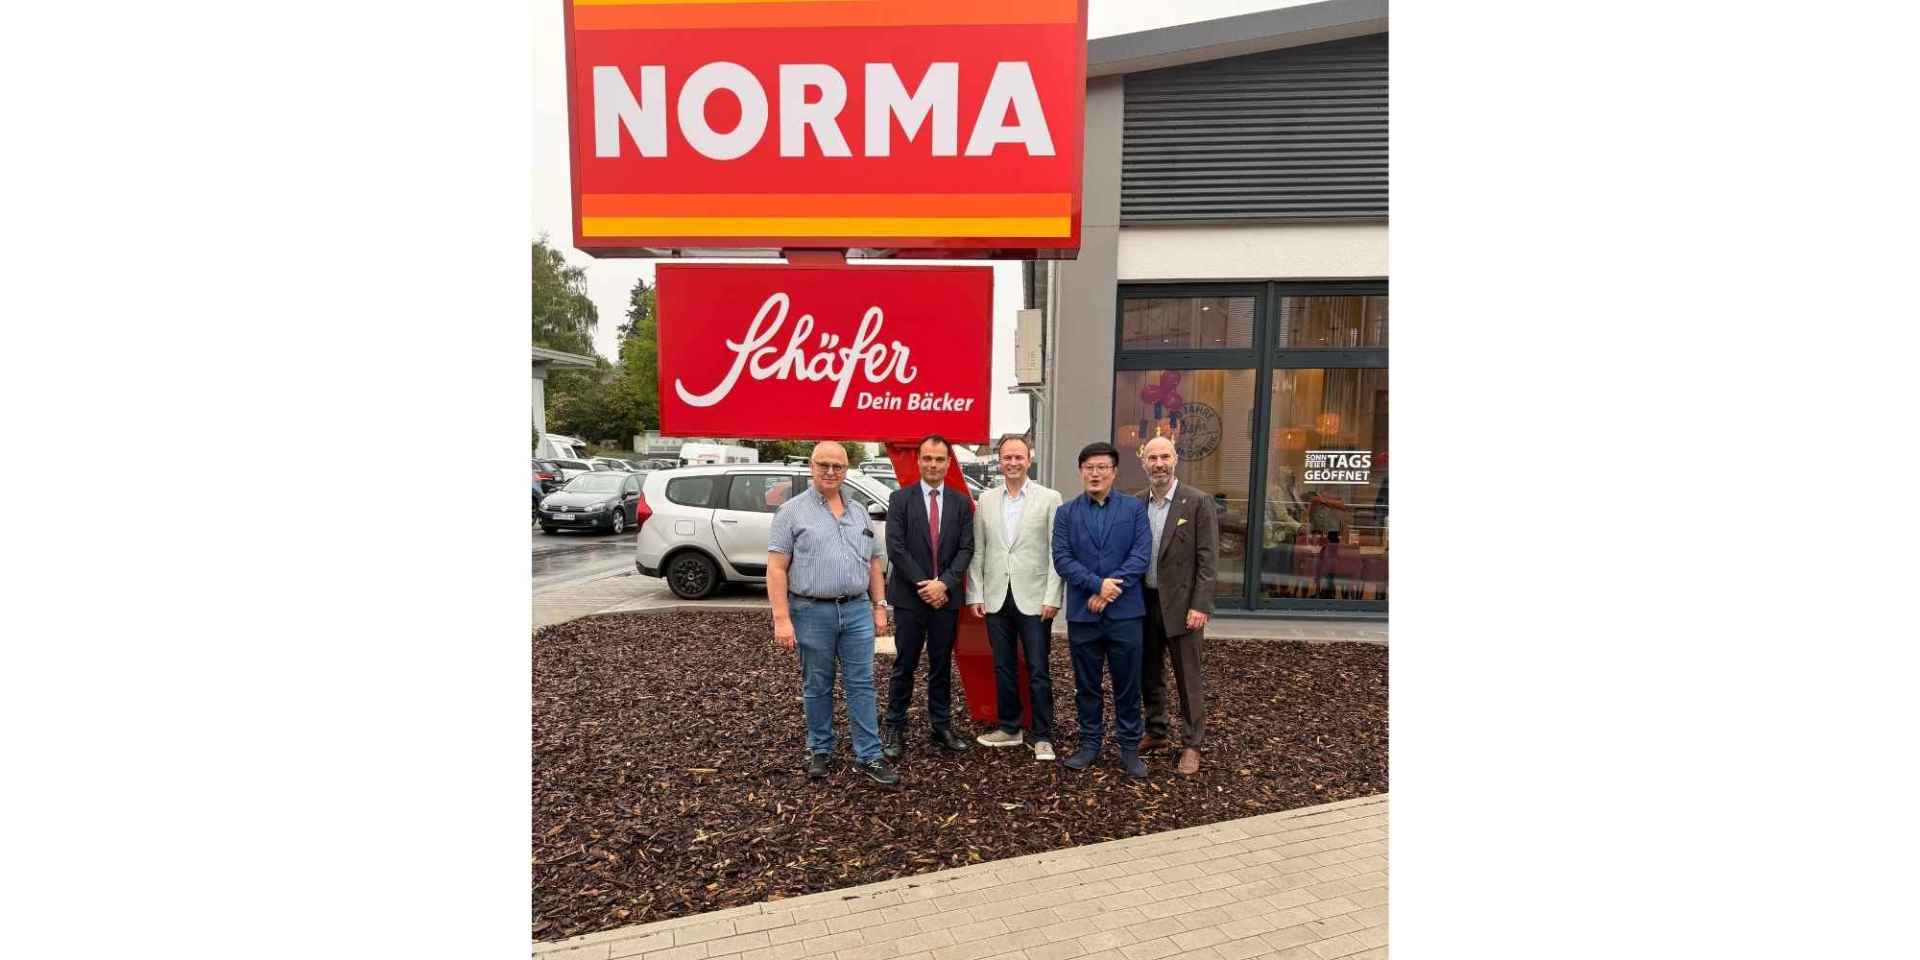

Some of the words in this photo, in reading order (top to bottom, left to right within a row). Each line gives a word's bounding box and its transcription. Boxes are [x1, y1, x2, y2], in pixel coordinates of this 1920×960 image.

[592, 61, 1056, 160] NORMA
[675, 292, 917, 407] Schäfer
[857, 392, 903, 410] Dein
[908, 392, 974, 412] Bäcker
[1328, 454, 1372, 468] TAGS
[1304, 468, 1370, 481] GEÖFFNET
